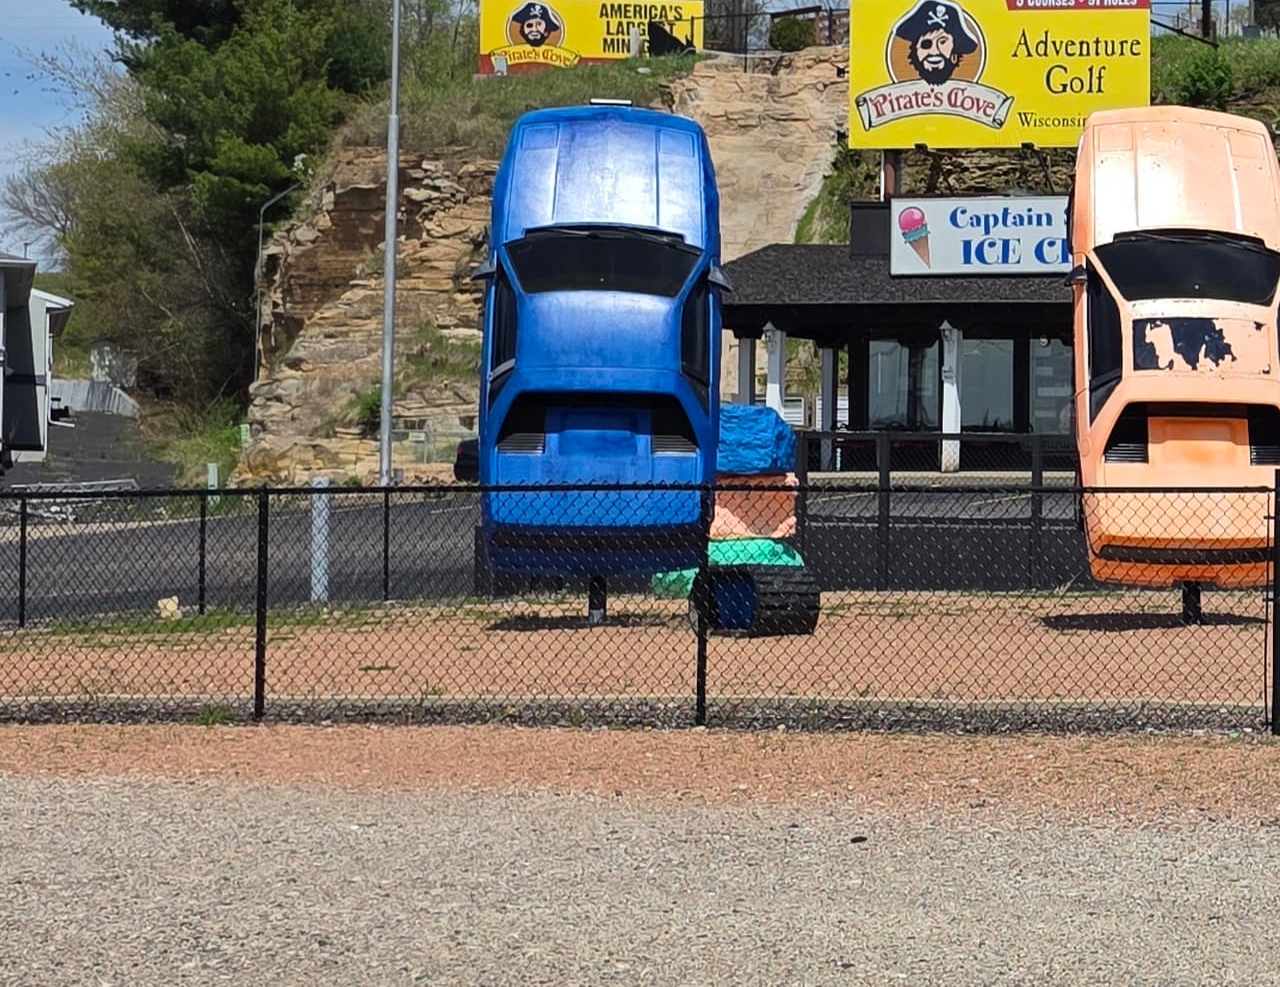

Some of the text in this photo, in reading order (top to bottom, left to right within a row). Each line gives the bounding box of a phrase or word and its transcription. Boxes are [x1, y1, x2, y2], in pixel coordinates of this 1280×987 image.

[599, 3, 683, 22] AMERICA'S
[606, 20, 676, 36] LARGT
[602, 38, 632, 53] MIN
[1011, 28, 1141, 58] Adventure
[1045, 64, 1106, 95] Golf
[870, 86, 997, 119] Pirate's Cove
[949, 206, 1053, 236] Captain
[961, 237, 1021, 266] ICE
